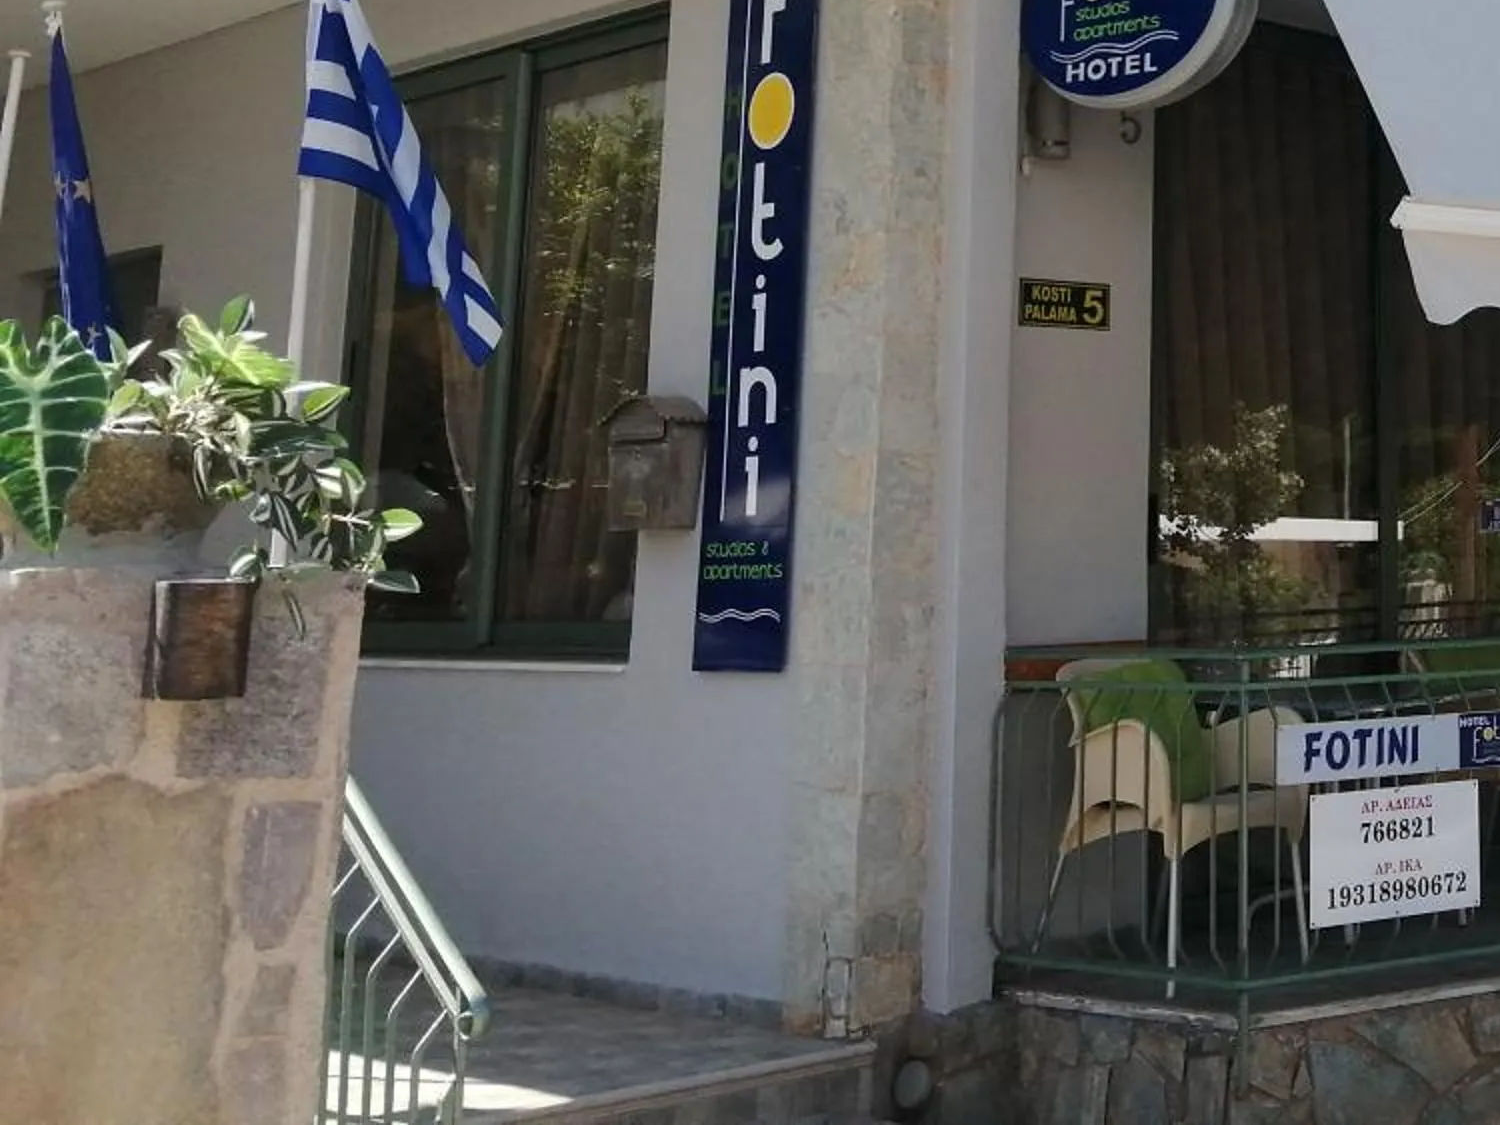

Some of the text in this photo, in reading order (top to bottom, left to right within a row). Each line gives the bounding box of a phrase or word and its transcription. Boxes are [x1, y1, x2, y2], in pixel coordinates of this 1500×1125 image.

[1066, 53, 1158, 83] HOTEL
[1031, 285, 1072, 302] KOSTI
[1083, 289, 1104, 324] 5
[1025, 304, 1077, 322] PALAMA
[1460, 716, 1491, 727] HOTEL
[1304, 725, 1420, 772] FOTINI
[1361, 815, 1435, 844] 766821
[1328, 871, 1467, 910] 19318980672
